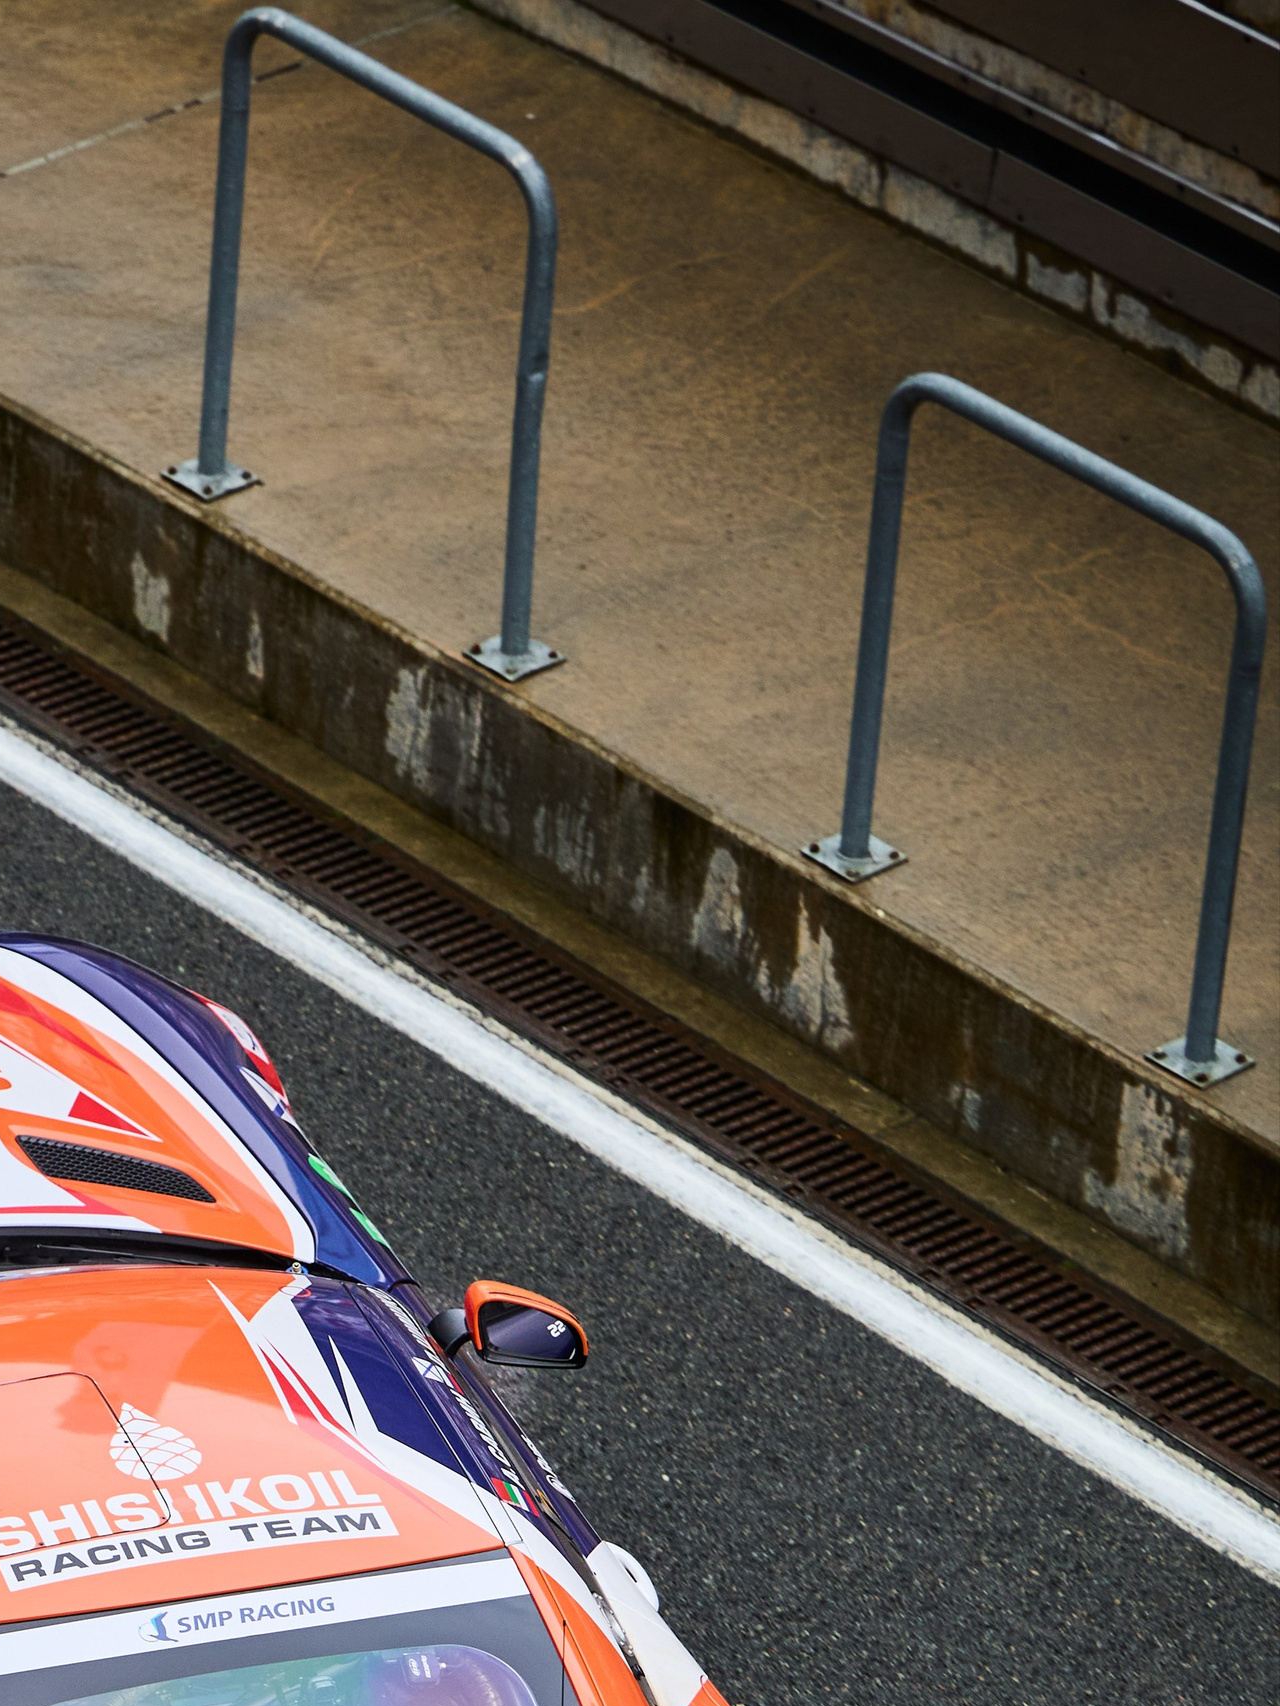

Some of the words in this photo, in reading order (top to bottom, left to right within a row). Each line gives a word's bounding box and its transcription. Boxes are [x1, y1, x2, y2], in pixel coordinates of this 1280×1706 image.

[10, 1530, 211, 1582] RACING
[229, 1512, 381, 1542] TEAM
[177, 1610, 233, 1634] SMP
[239, 1596, 335, 1624] RACING
